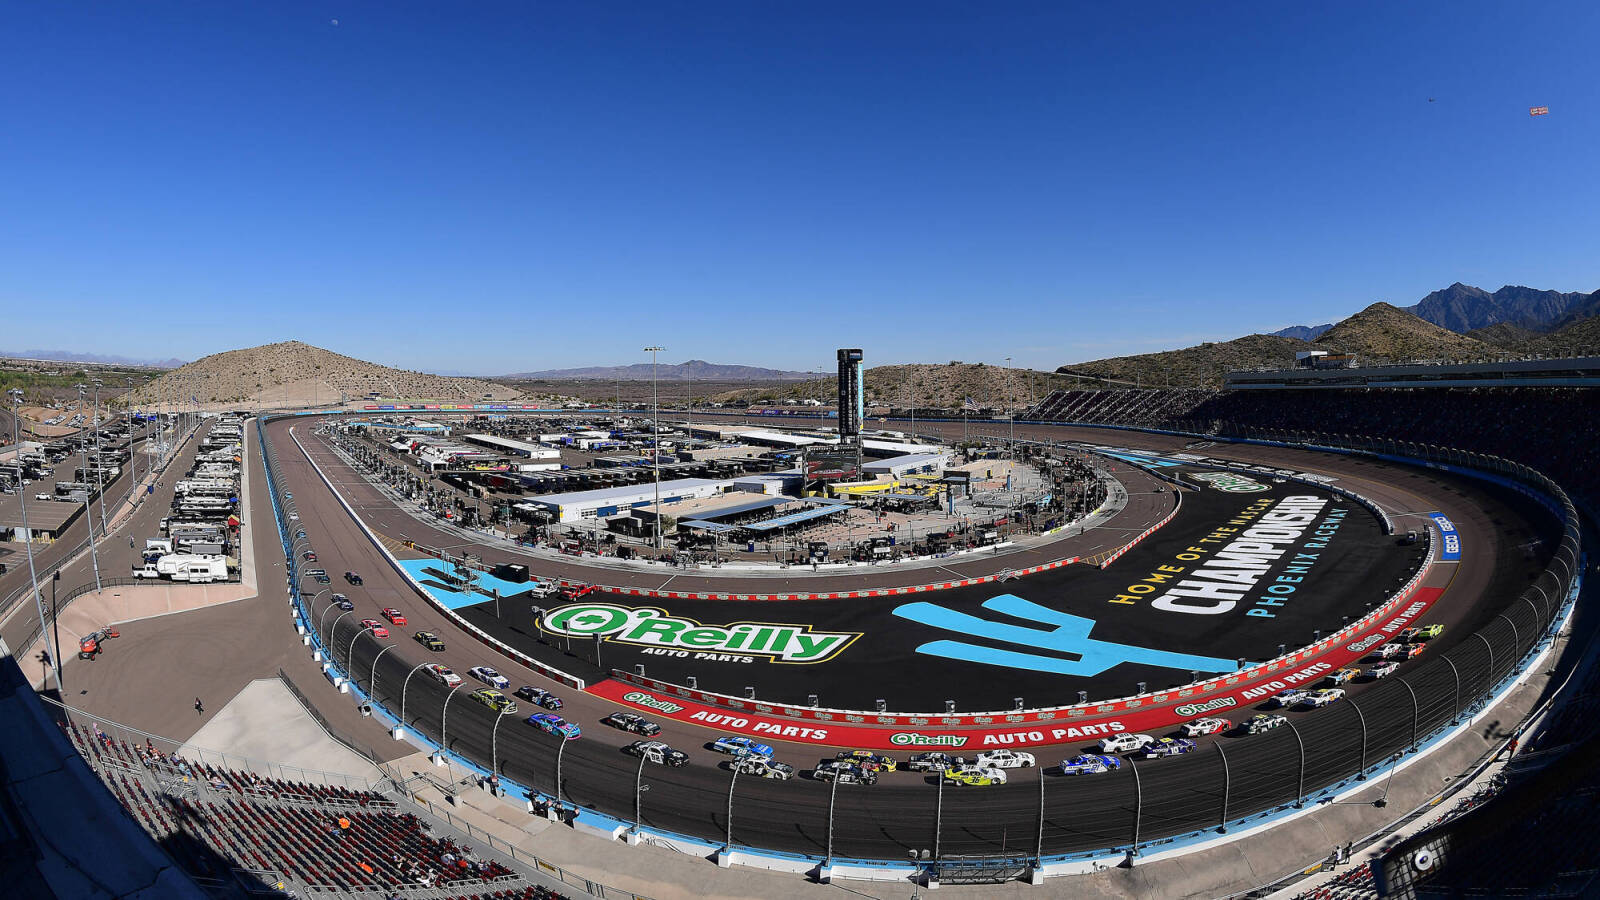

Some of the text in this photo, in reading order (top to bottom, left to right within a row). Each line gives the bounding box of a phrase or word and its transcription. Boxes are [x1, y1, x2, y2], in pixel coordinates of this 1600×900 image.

[1434, 516, 1454, 532] GEICO
[1445, 535, 1459, 553] GEICO
[1108, 497, 1276, 605] HOME OF THE NASCAR
[1151, 495, 1329, 615] CHAMPIONSHIP
[1246, 553, 1321, 618] PHOENIX
[1303, 508, 1349, 549] RACEWAY
[545, 604, 851, 661] O'Reilly
[1381, 616, 1408, 633] AUTO
[1400, 601, 1427, 620] PARTS
[641, 647, 754, 663] AUTO PARTS
[1174, 661, 1332, 716] O'Reilly AUTO PARTS
[623, 691, 685, 713] O'Reilly
[690, 711, 749, 729] AUTO
[752, 721, 828, 740] PARTS
[890, 721, 1126, 747] O'Reilly AUTO PARTS
